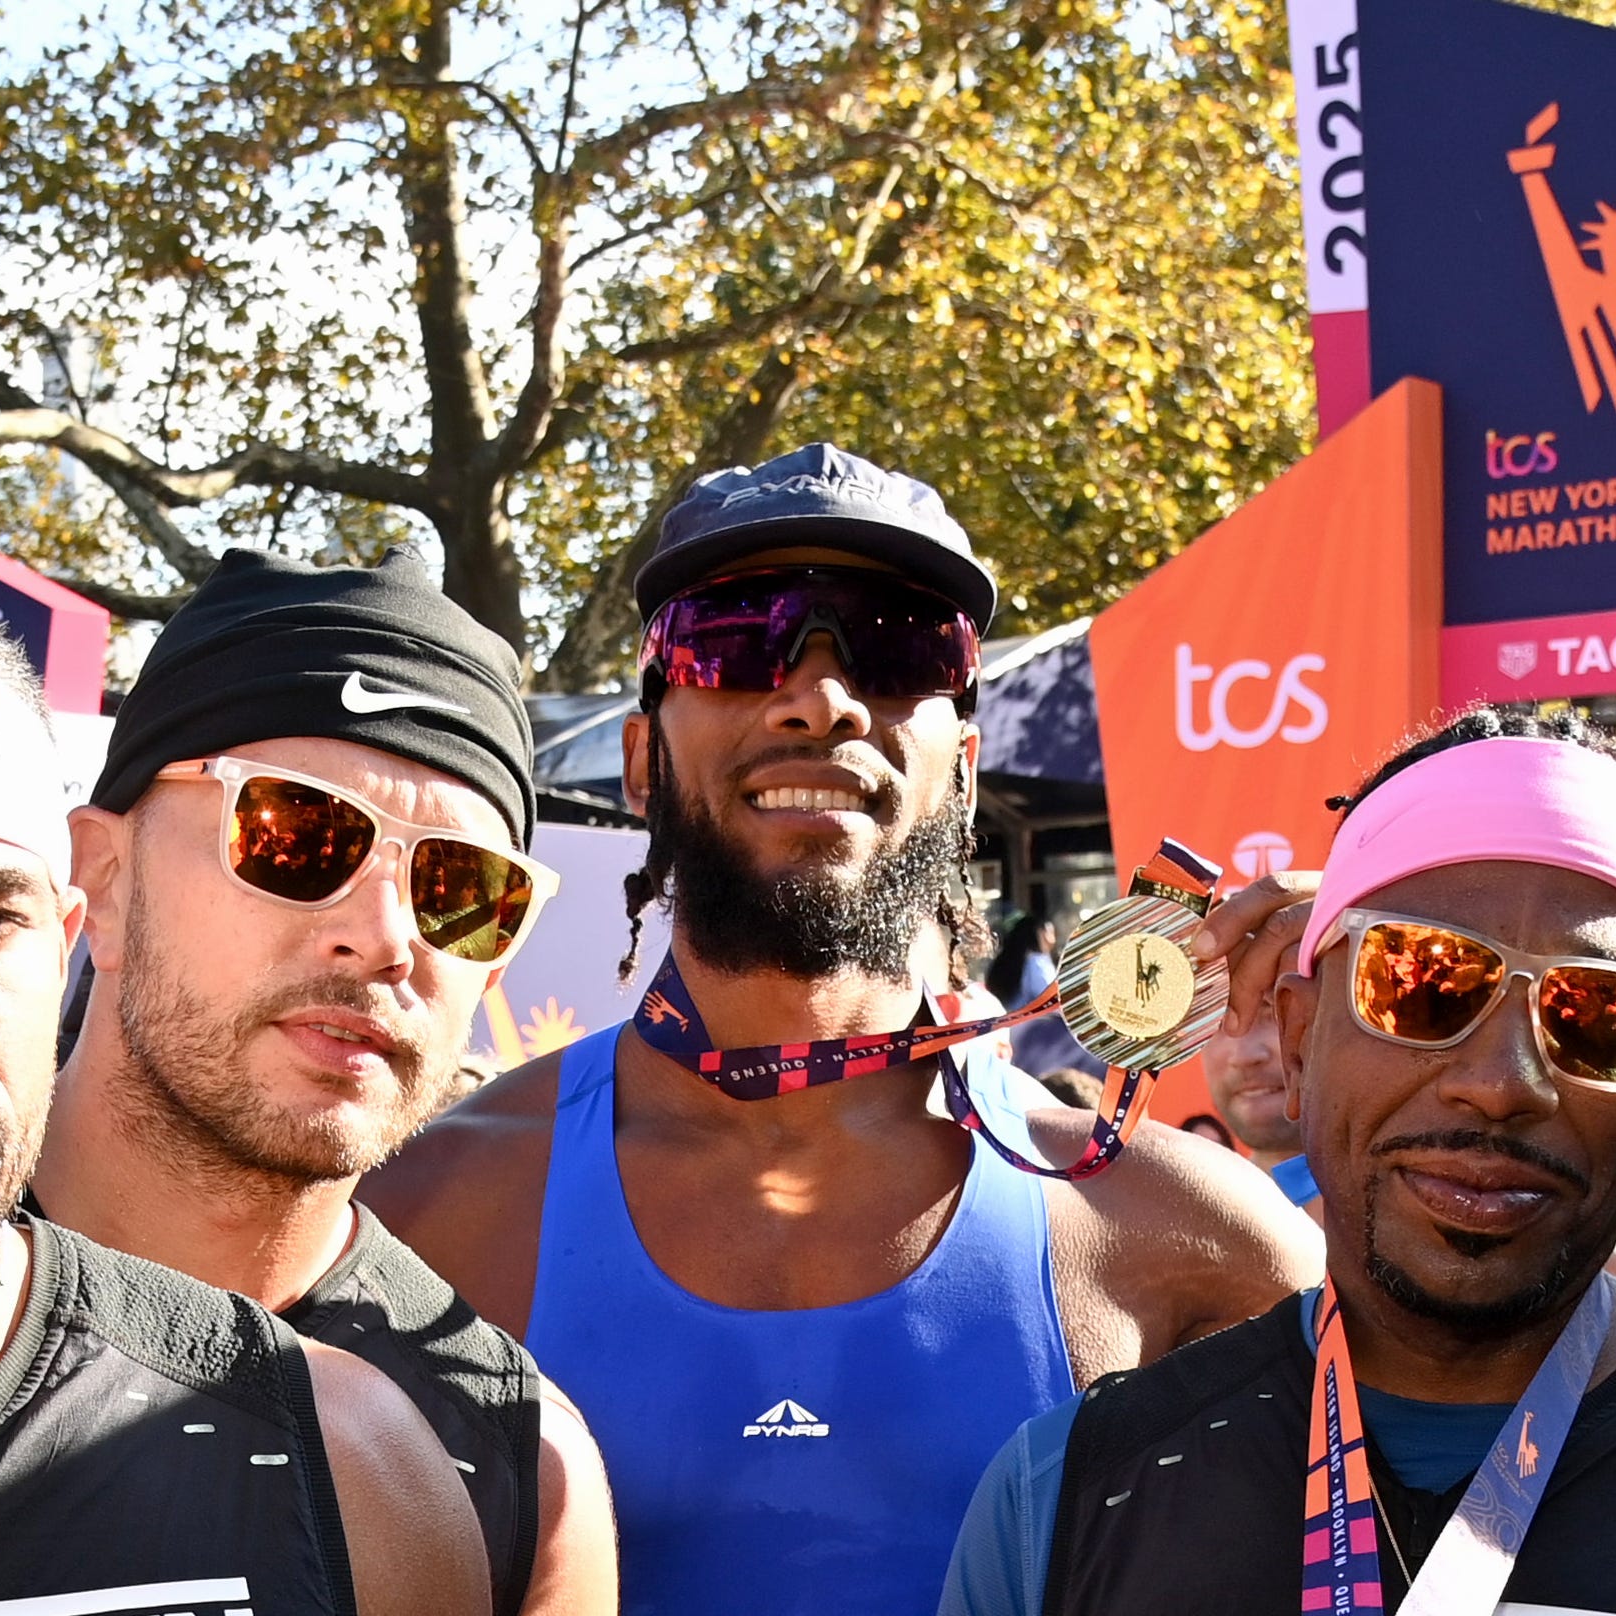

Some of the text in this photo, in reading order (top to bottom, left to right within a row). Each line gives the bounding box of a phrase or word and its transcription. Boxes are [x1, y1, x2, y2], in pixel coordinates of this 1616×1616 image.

[1316, 28, 1364, 278] 2025
[1485, 429, 1557, 480] tcs
[1486, 487, 1555, 520] NEW
[1173, 641, 1329, 752] tcs
[729, 1056, 807, 1082] QUEENS
[1325, 1364, 1337, 1416] STATEN
[1328, 1417, 1342, 1474] ISLAND
[1330, 1487, 1348, 1567] BROOKLYN
